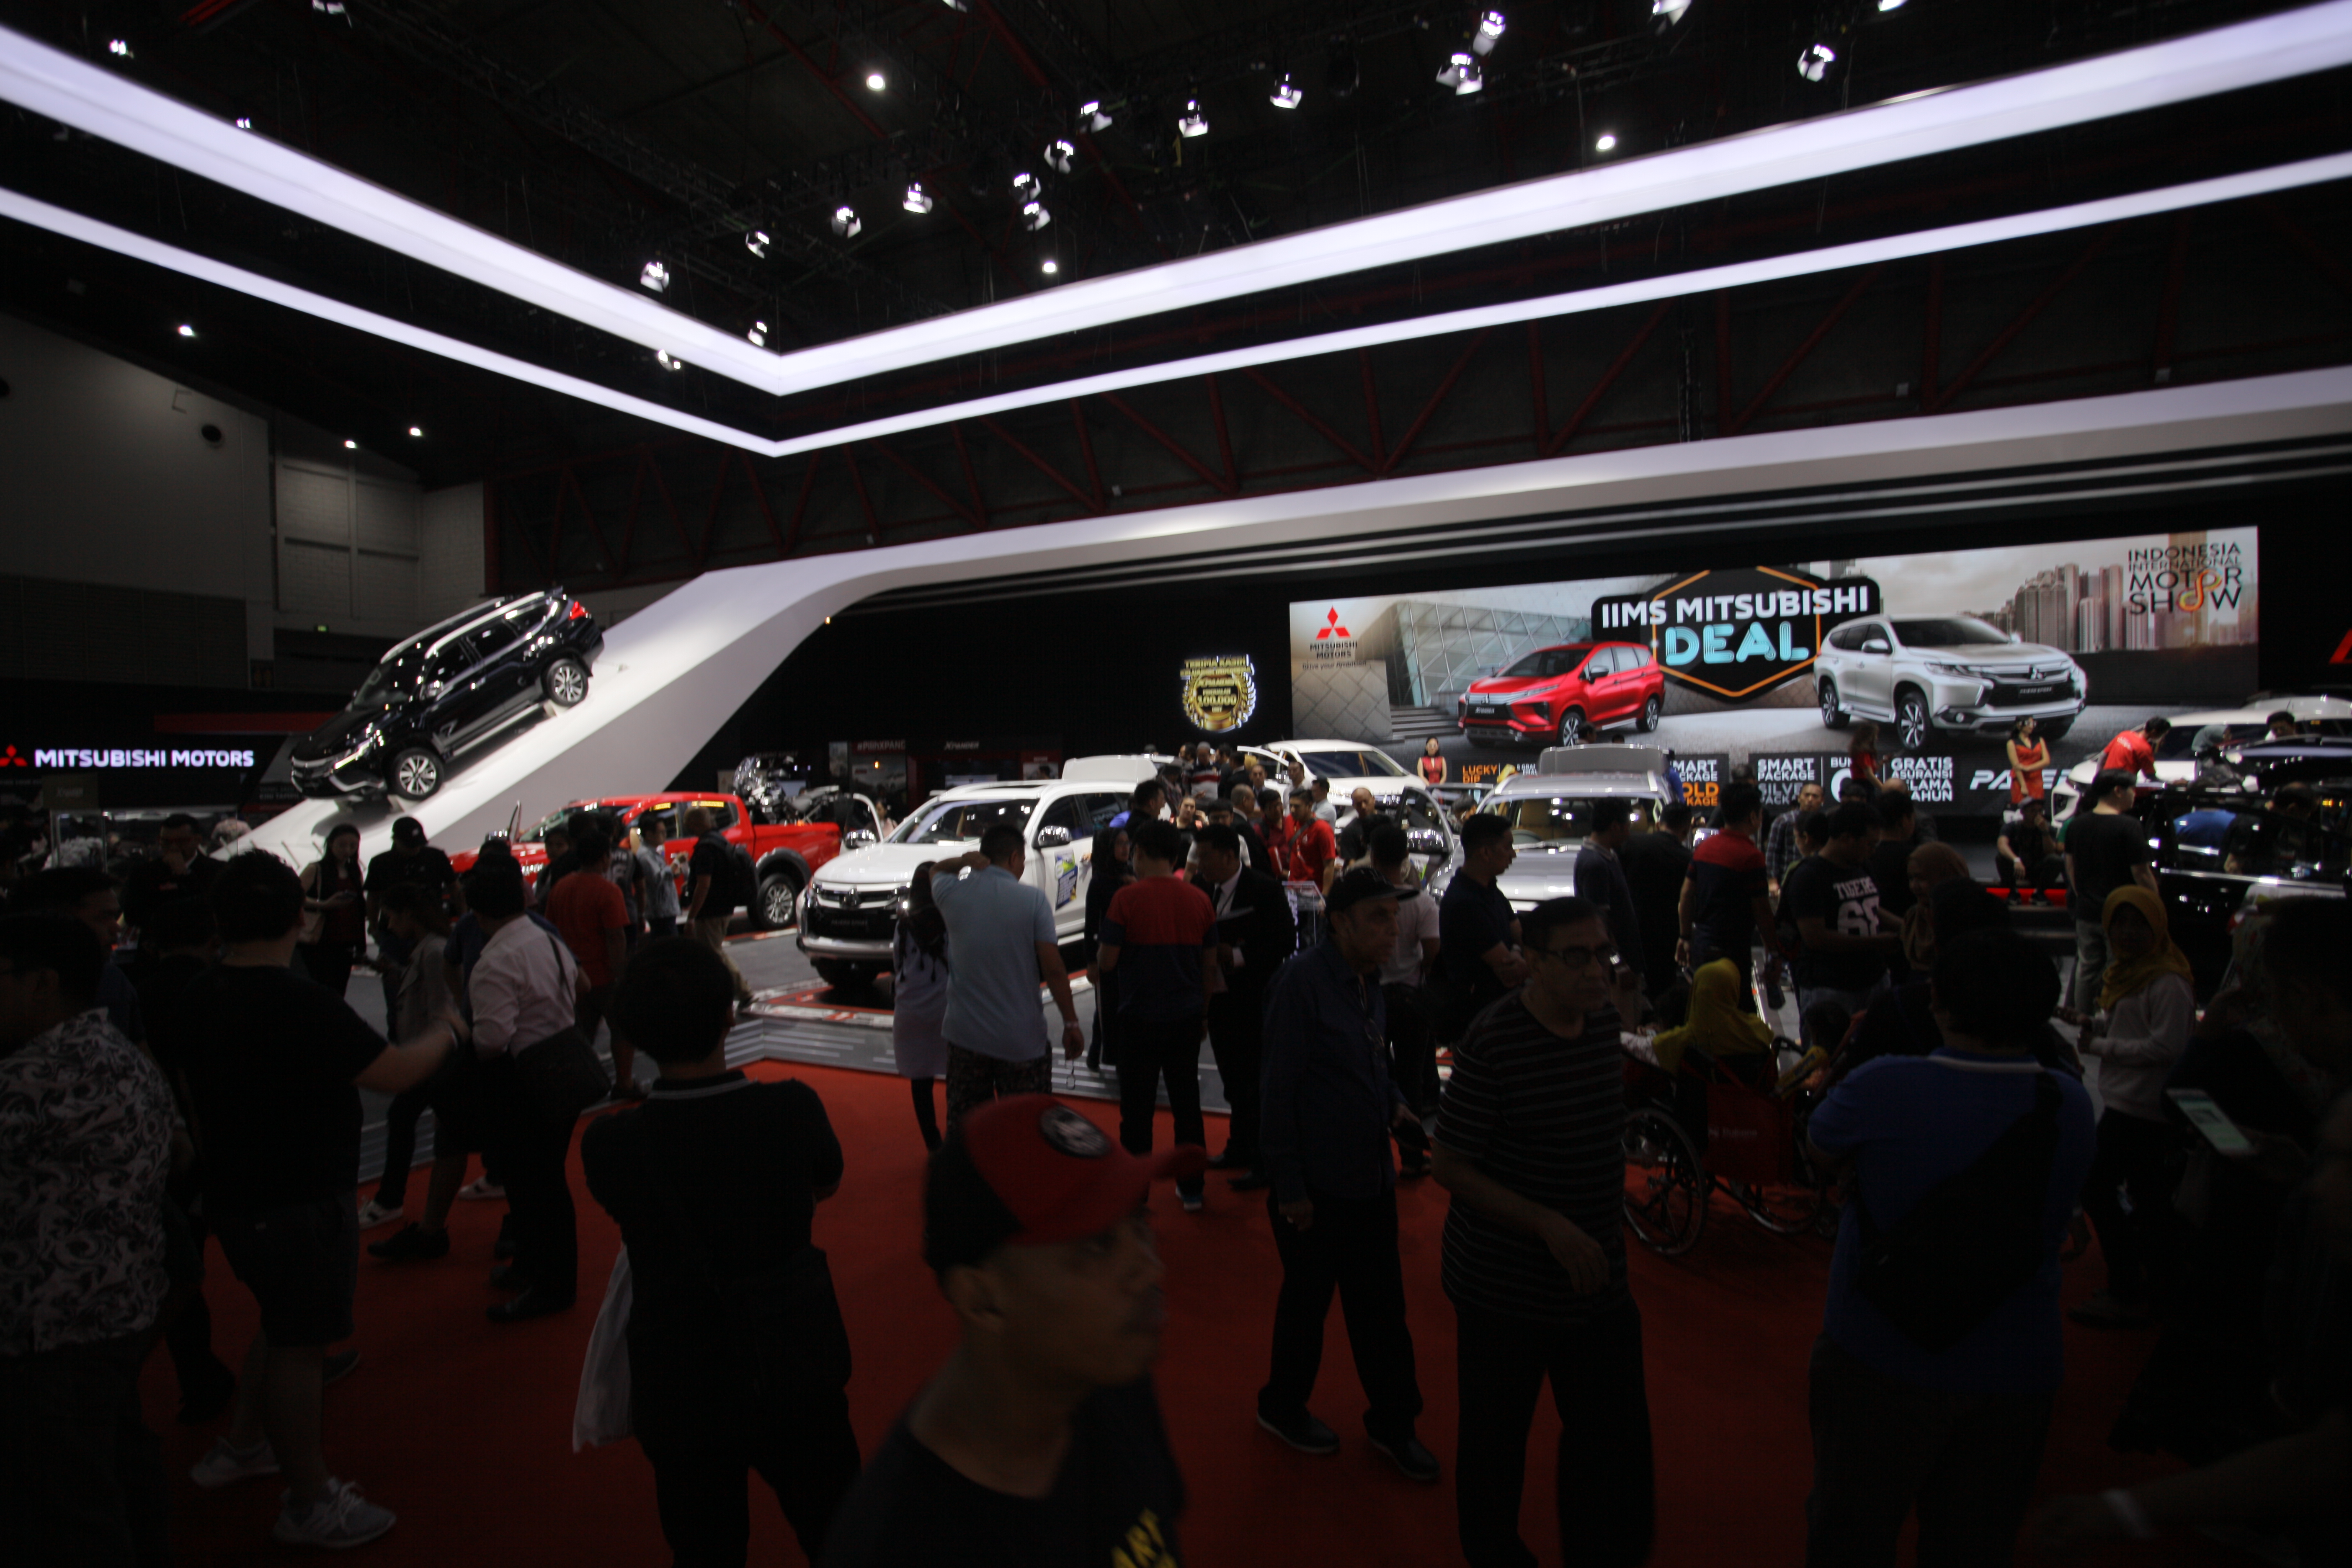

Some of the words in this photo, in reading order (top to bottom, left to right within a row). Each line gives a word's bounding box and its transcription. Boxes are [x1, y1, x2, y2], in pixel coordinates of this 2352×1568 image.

[2128, 542, 2241, 562] INDONESIA
[2128, 556, 2239, 572] INTERNATIONAL
[2129, 567, 2241, 591] MOTOR
[1602, 601, 1666, 628] IIMS
[1676, 586, 1868, 623] MITSUBISHI
[2130, 587, 2241, 614] SHOW
[1310, 640, 1357, 651] MITSUBISHI
[1665, 621, 1809, 666] DEAL
[1316, 651, 1351, 659] MOTORS
[1197, 694, 1237, 707] 100.000
[34, 749, 166, 768] MITSUBISHI
[172, 750, 254, 767] MOTORS
[1757, 758, 1815, 772] SMART
[1891, 756, 1953, 771] GRATIS
[1462, 764, 1498, 775] LUCKY
[1670, 759, 1717, 772] MART
[1462, 774, 1481, 784] DIP
[1679, 771, 1718, 782] CKAGE
[1757, 770, 1815, 781] PACKAGE
[1891, 769, 1953, 780] ASURANSI
[1682, 781, 1720, 797] OLD
[1758, 782, 1803, 795] SILVE
[1906, 779, 1952, 791] LAMA
[1686, 797, 1719, 807] KAGE
[1911, 790, 1953, 802] AHUN
[1832, 876, 1878, 900] TIGERS
